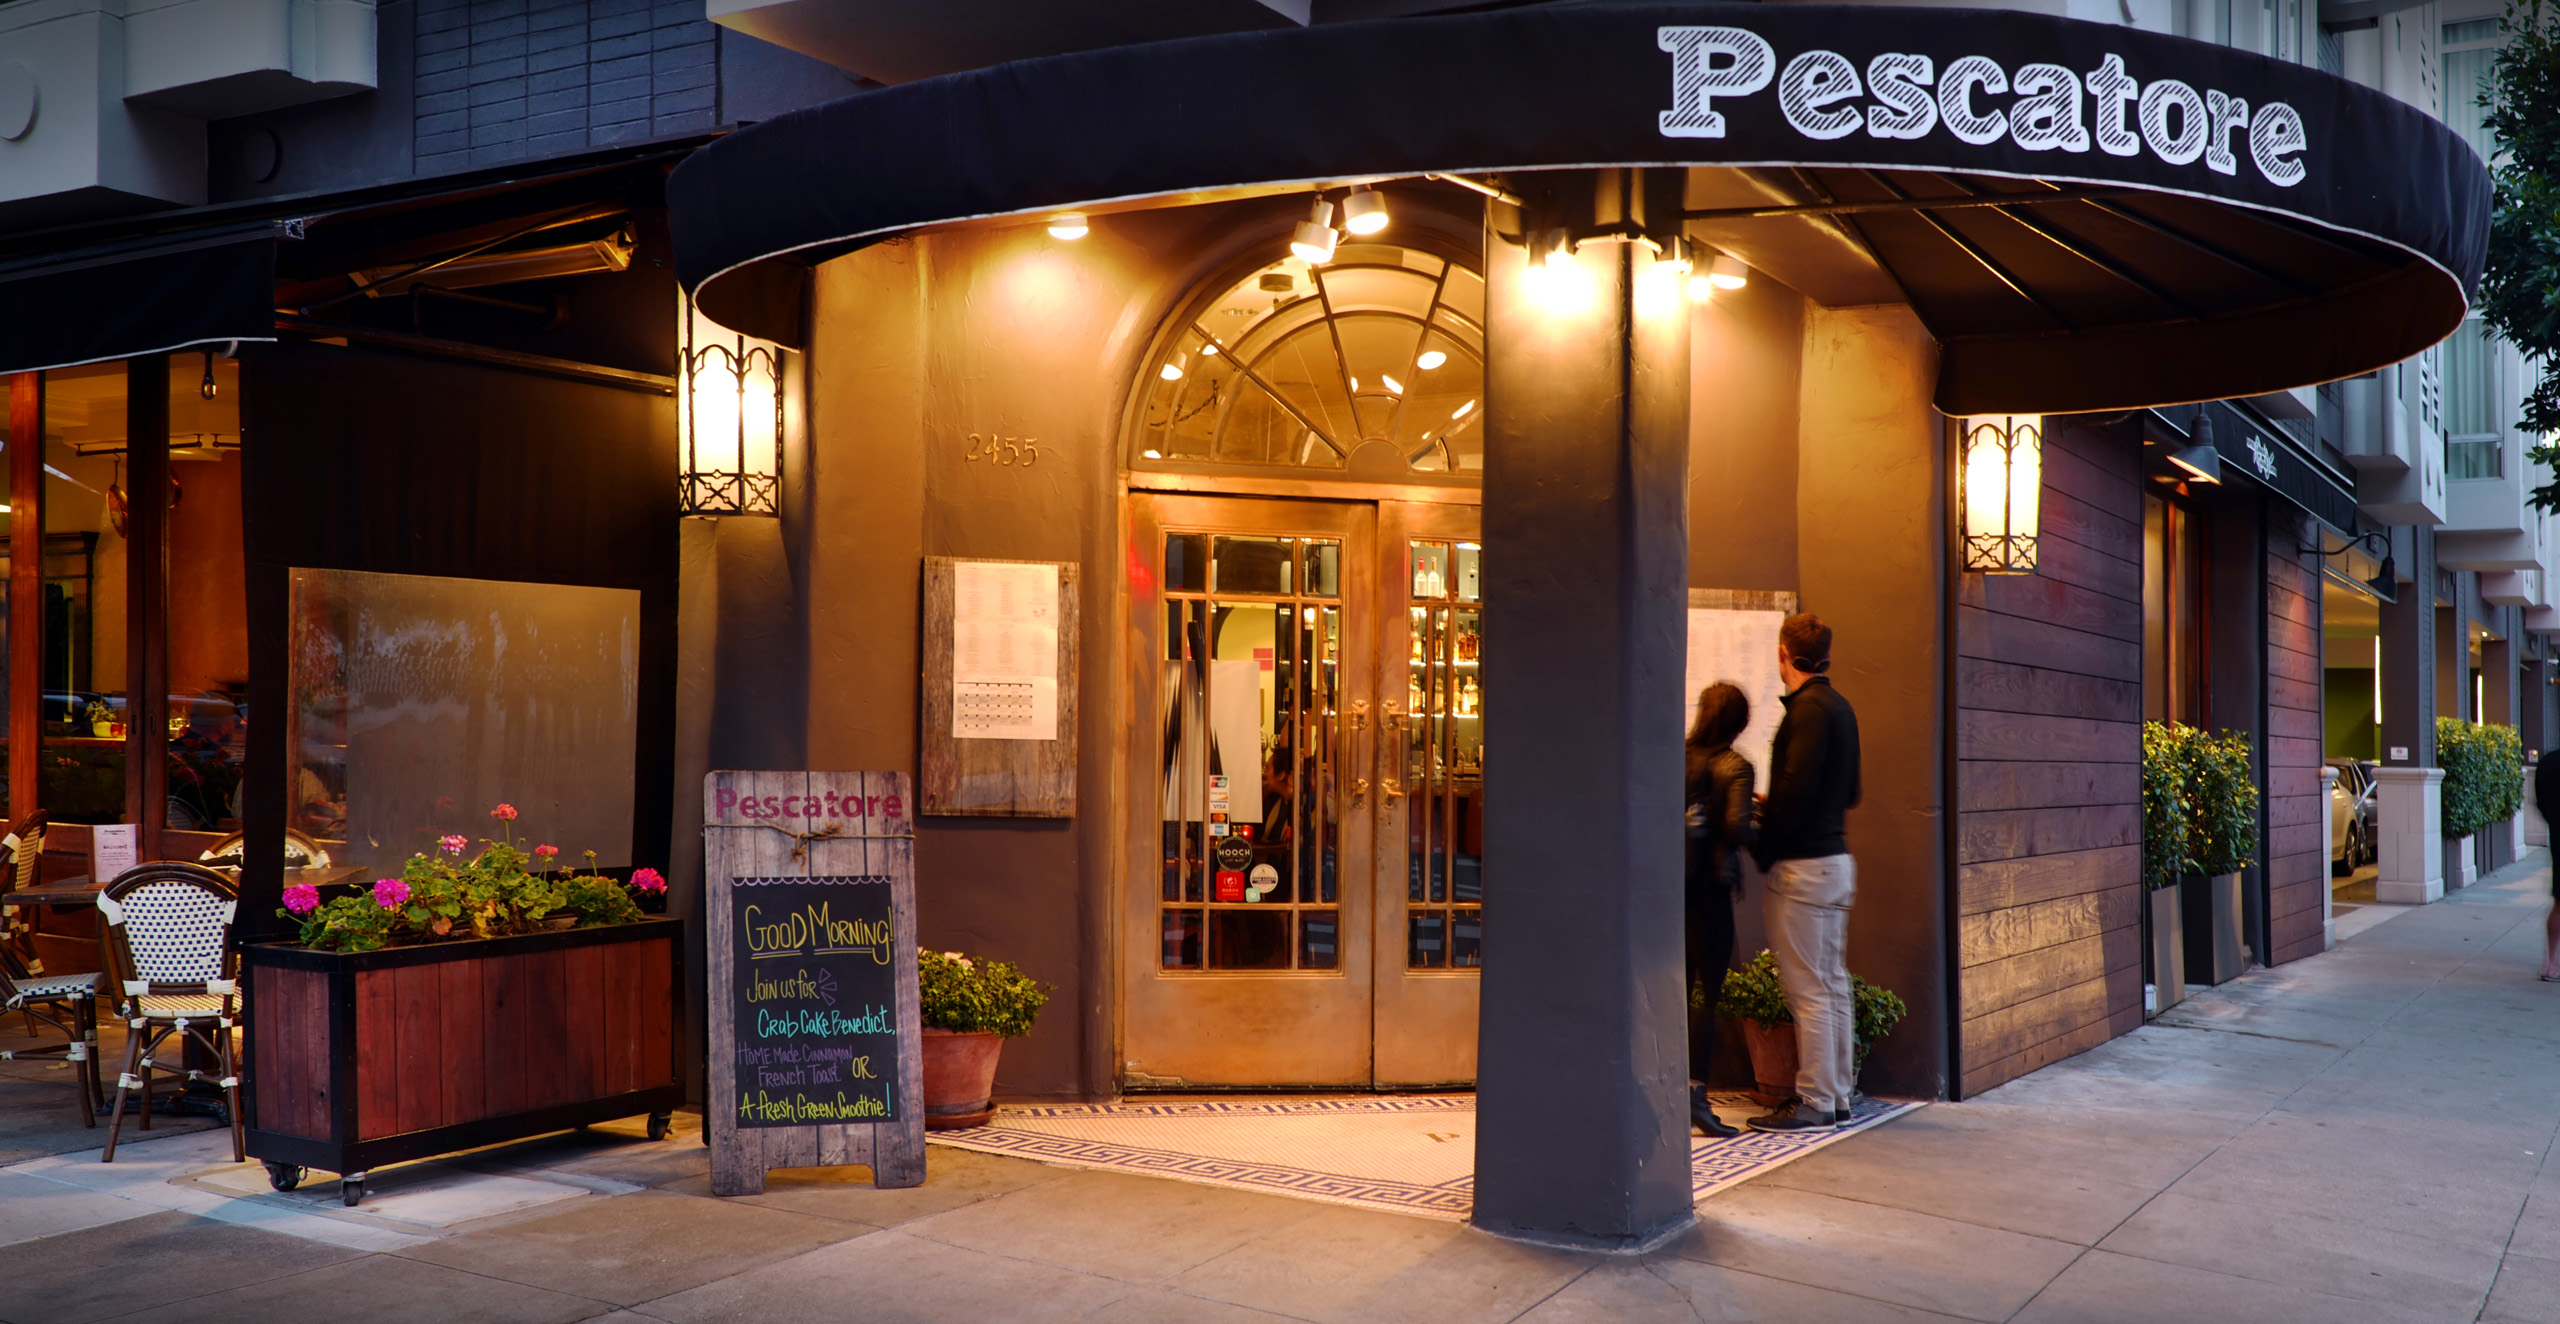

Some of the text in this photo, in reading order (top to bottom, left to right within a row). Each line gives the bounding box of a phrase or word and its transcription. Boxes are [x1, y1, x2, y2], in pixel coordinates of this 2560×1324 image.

[1657, 25, 2307, 187] Pescatore
[965, 433, 1038, 467] 2455
[715, 788, 903, 819] Pescatore
[852, 1055, 878, 1080] OR
[739, 1092, 756, 1120] A
